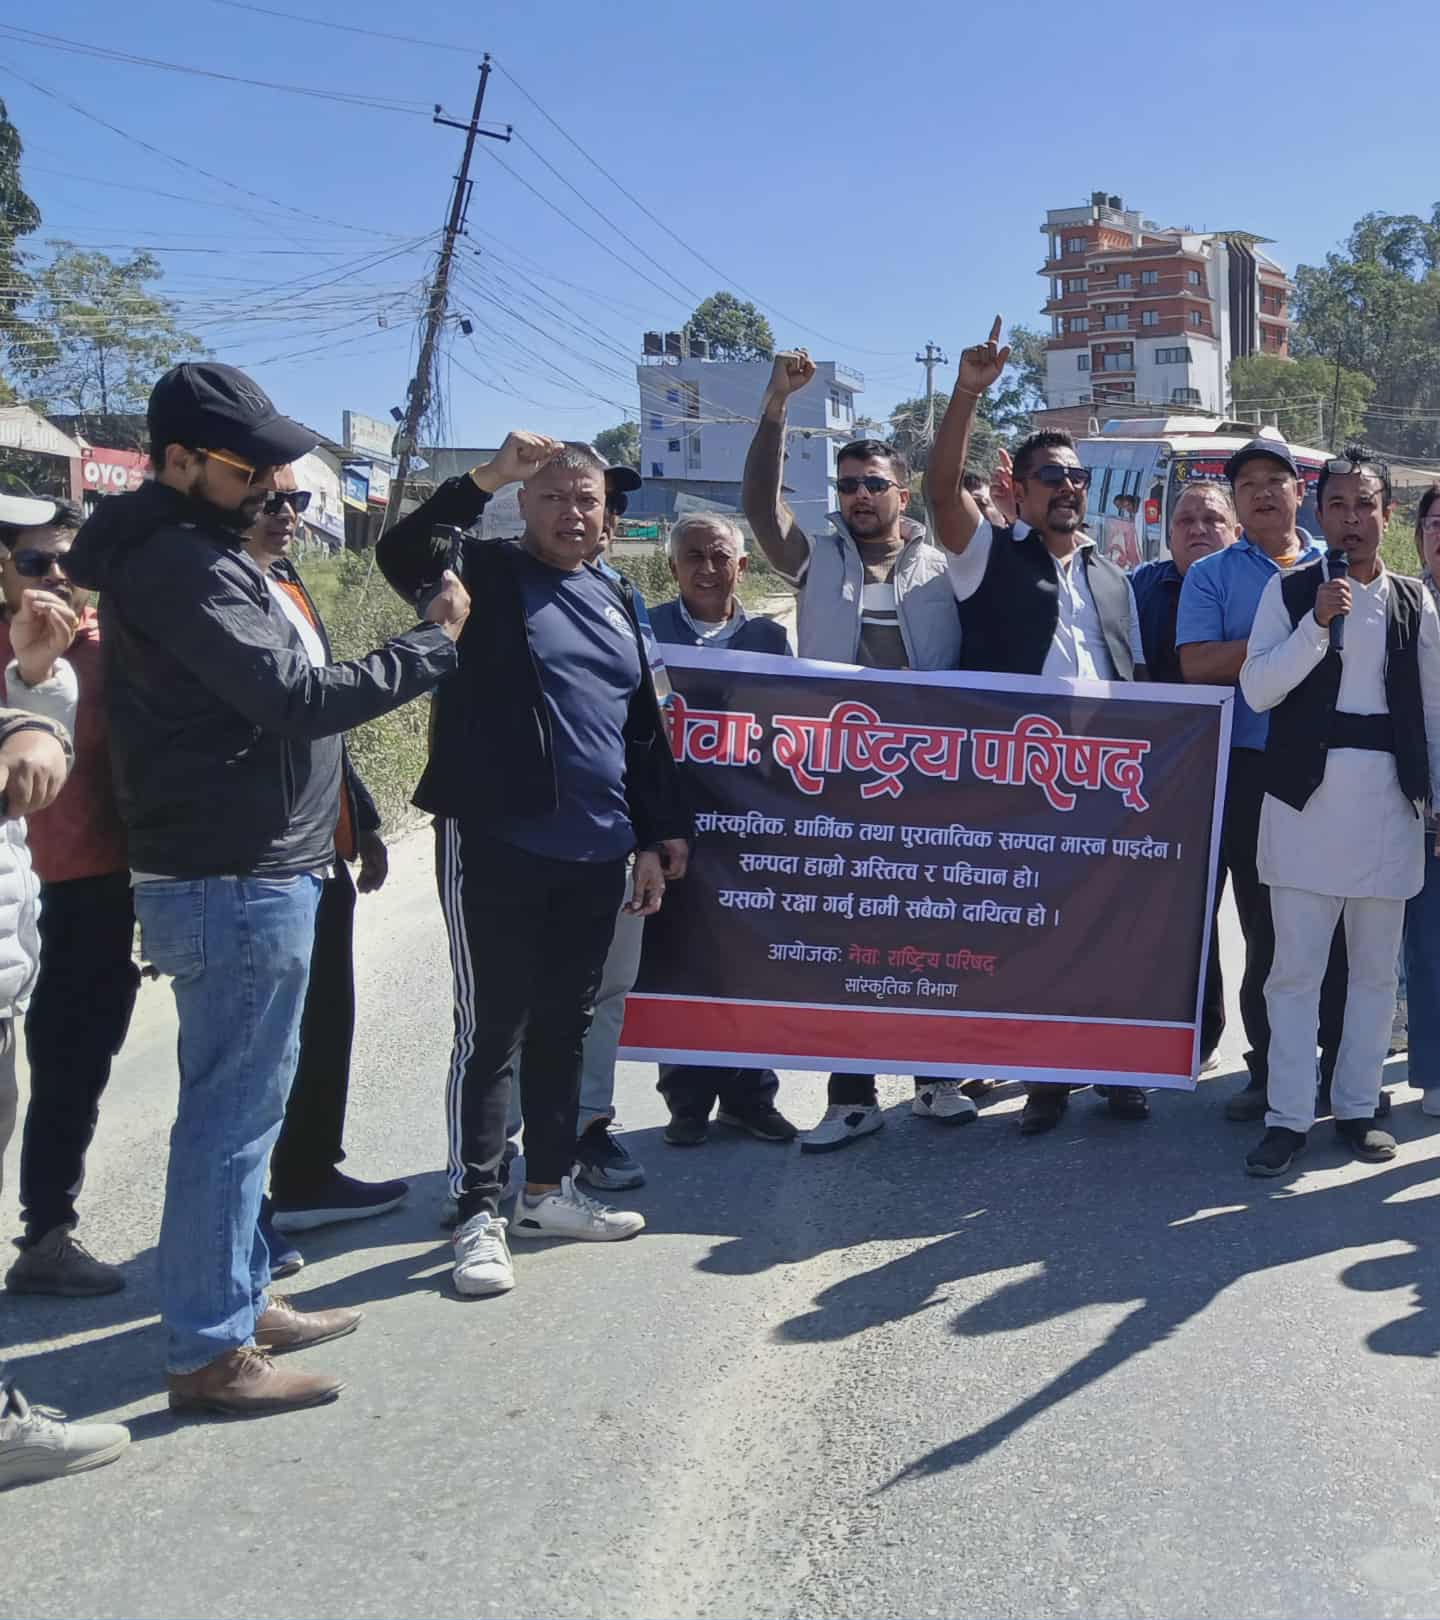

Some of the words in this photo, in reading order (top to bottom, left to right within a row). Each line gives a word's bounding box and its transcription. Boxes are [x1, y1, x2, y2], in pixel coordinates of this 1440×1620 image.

[84, 461, 128, 487] OYO
[772, 701, 968, 799] राष्ट्रिय
[971, 714, 1151, 812] परिषद्
[794, 815, 854, 840] धार्मिक
[859, 823, 895, 842] तथा
[999, 831, 1056, 852] सम्पदा
[739, 853, 800, 874] सम्पदा
[804, 854, 846, 878] हाम्रो
[850, 856, 919, 881] अस्तित्व
[924, 864, 938, 882] र
[943, 861, 1008, 886] पहिचान
[718, 888, 776, 910] यसको
[781, 892, 818, 913] रक्षा
[823, 893, 854, 919] गर्नु
[859, 894, 899, 917] हामी
[905, 896, 956, 920] सबैको
[962, 899, 1022, 924] दायित्व
[844, 976, 913, 999] सांस्कृतिक
[916, 978, 961, 998] विभाग
